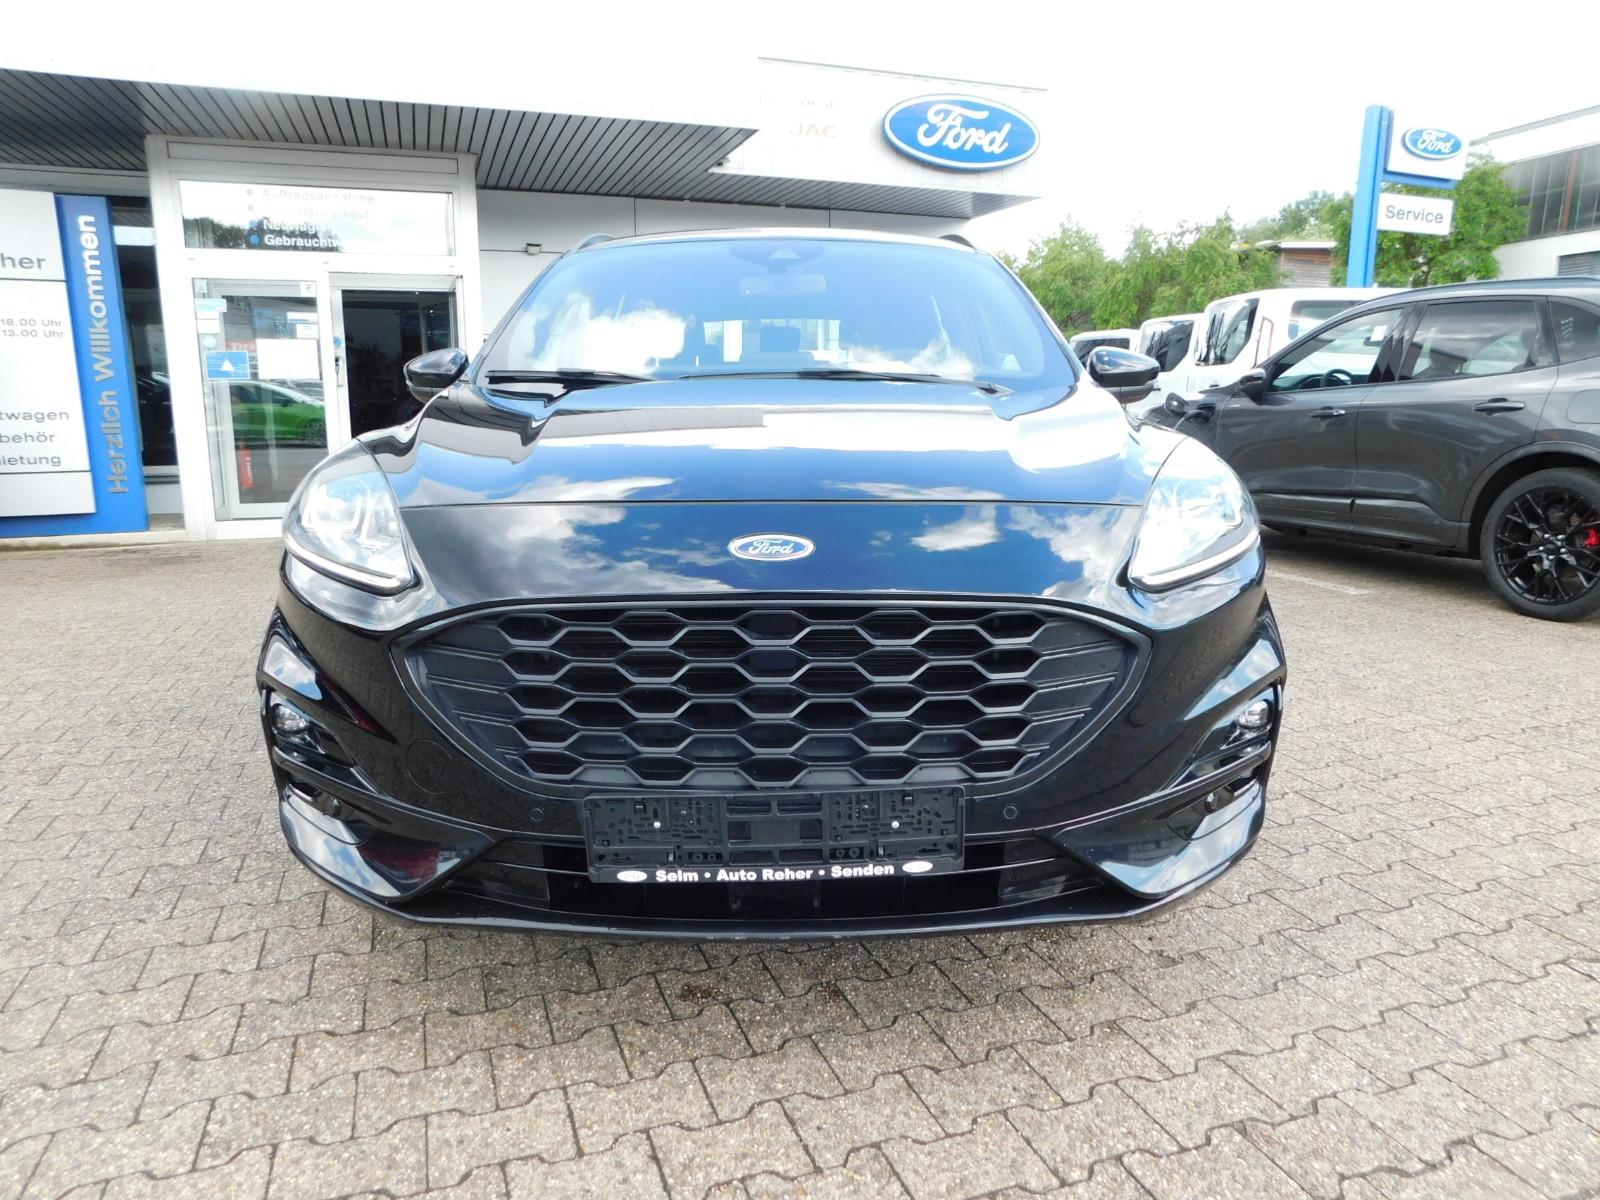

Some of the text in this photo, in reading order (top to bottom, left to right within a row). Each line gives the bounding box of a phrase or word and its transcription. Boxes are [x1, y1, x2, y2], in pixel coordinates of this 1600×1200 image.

[789, 122, 838, 139] JAC
[917, 103, 1012, 154] Ford
[1416, 130, 1455, 153] Ford
[1385, 205, 1444, 224] Service
[1, 318, 62, 328] 18.00 Uhr
[2, 329, 64, 339] 13.00 Uhr
[77, 214, 129, 494] Herzlich Willkommen
[0, 455, 62, 467] ietung
[748, 539, 795, 554] Ford
[655, 869, 699, 882] Selm
[716, 868, 757, 881] Auto
[762, 868, 814, 881] Reher
[831, 864, 895, 878] Senden
